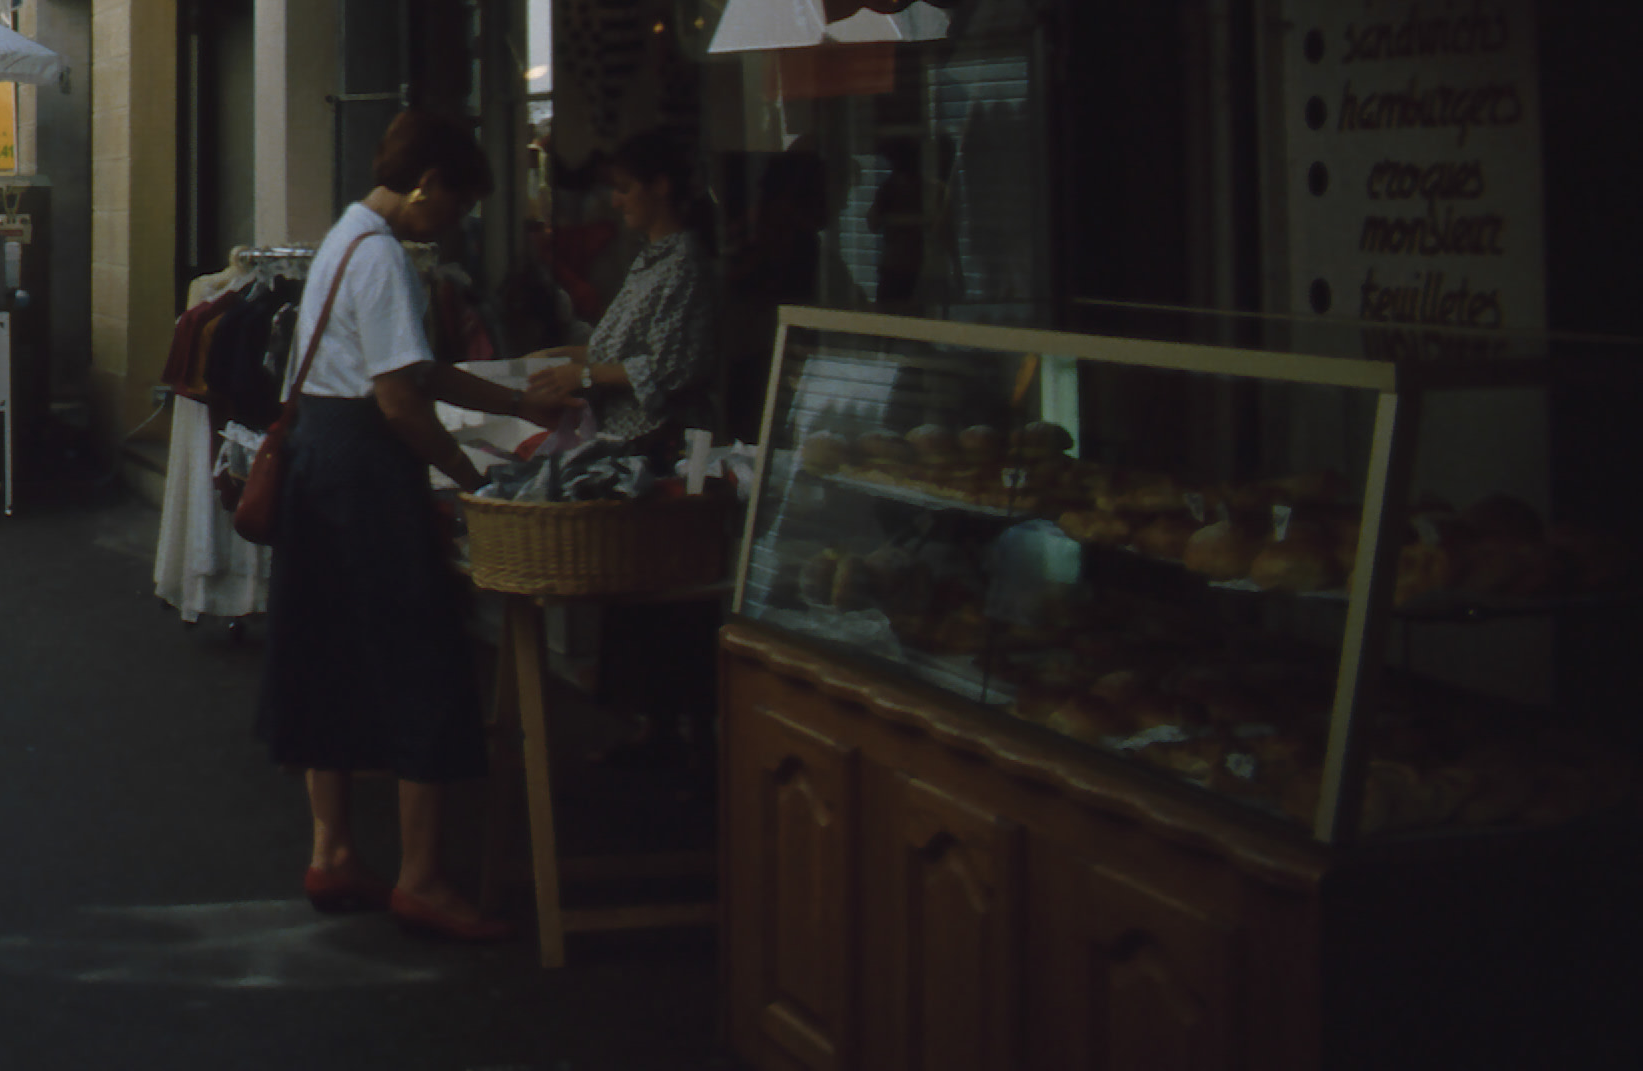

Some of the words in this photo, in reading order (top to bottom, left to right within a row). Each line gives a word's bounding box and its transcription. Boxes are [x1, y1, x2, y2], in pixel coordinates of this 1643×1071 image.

[1338, 76, 1521, 147] hamburgers
[1368, 159, 1484, 215] croques
[1359, 205, 1506, 256] monsieur
